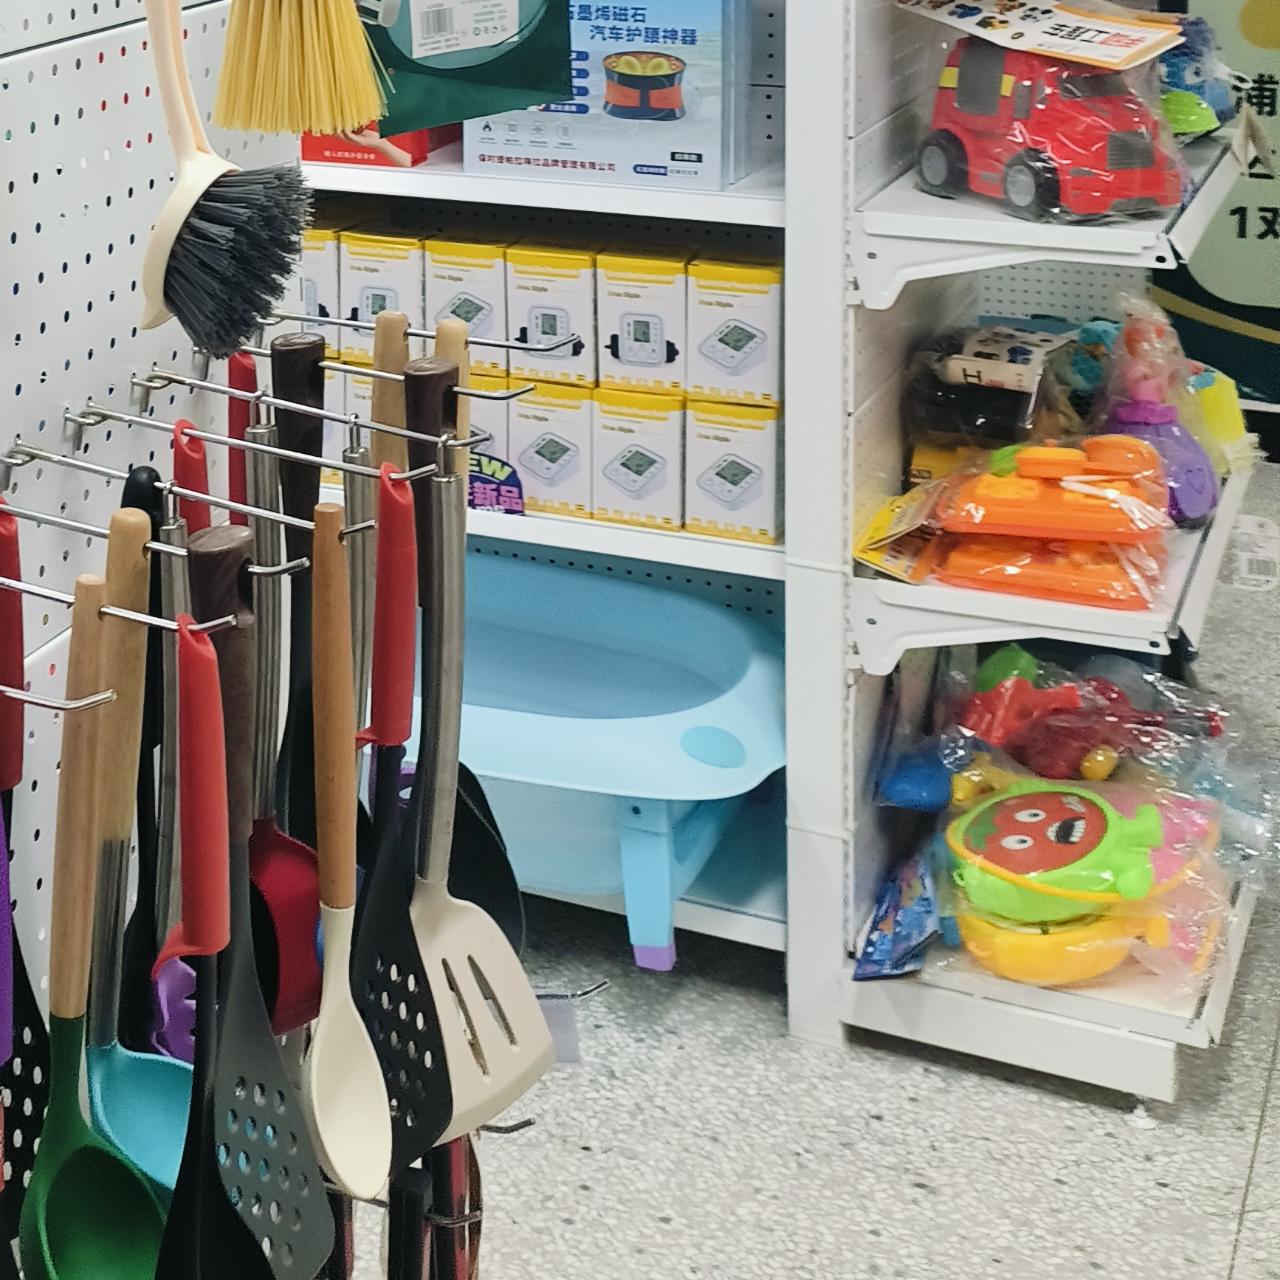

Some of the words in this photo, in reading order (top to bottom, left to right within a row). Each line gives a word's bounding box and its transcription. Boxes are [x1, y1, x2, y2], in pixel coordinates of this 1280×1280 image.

[590, 24, 698, 46] 汽车护腰神器
[469, 482, 524, 511] 新品
